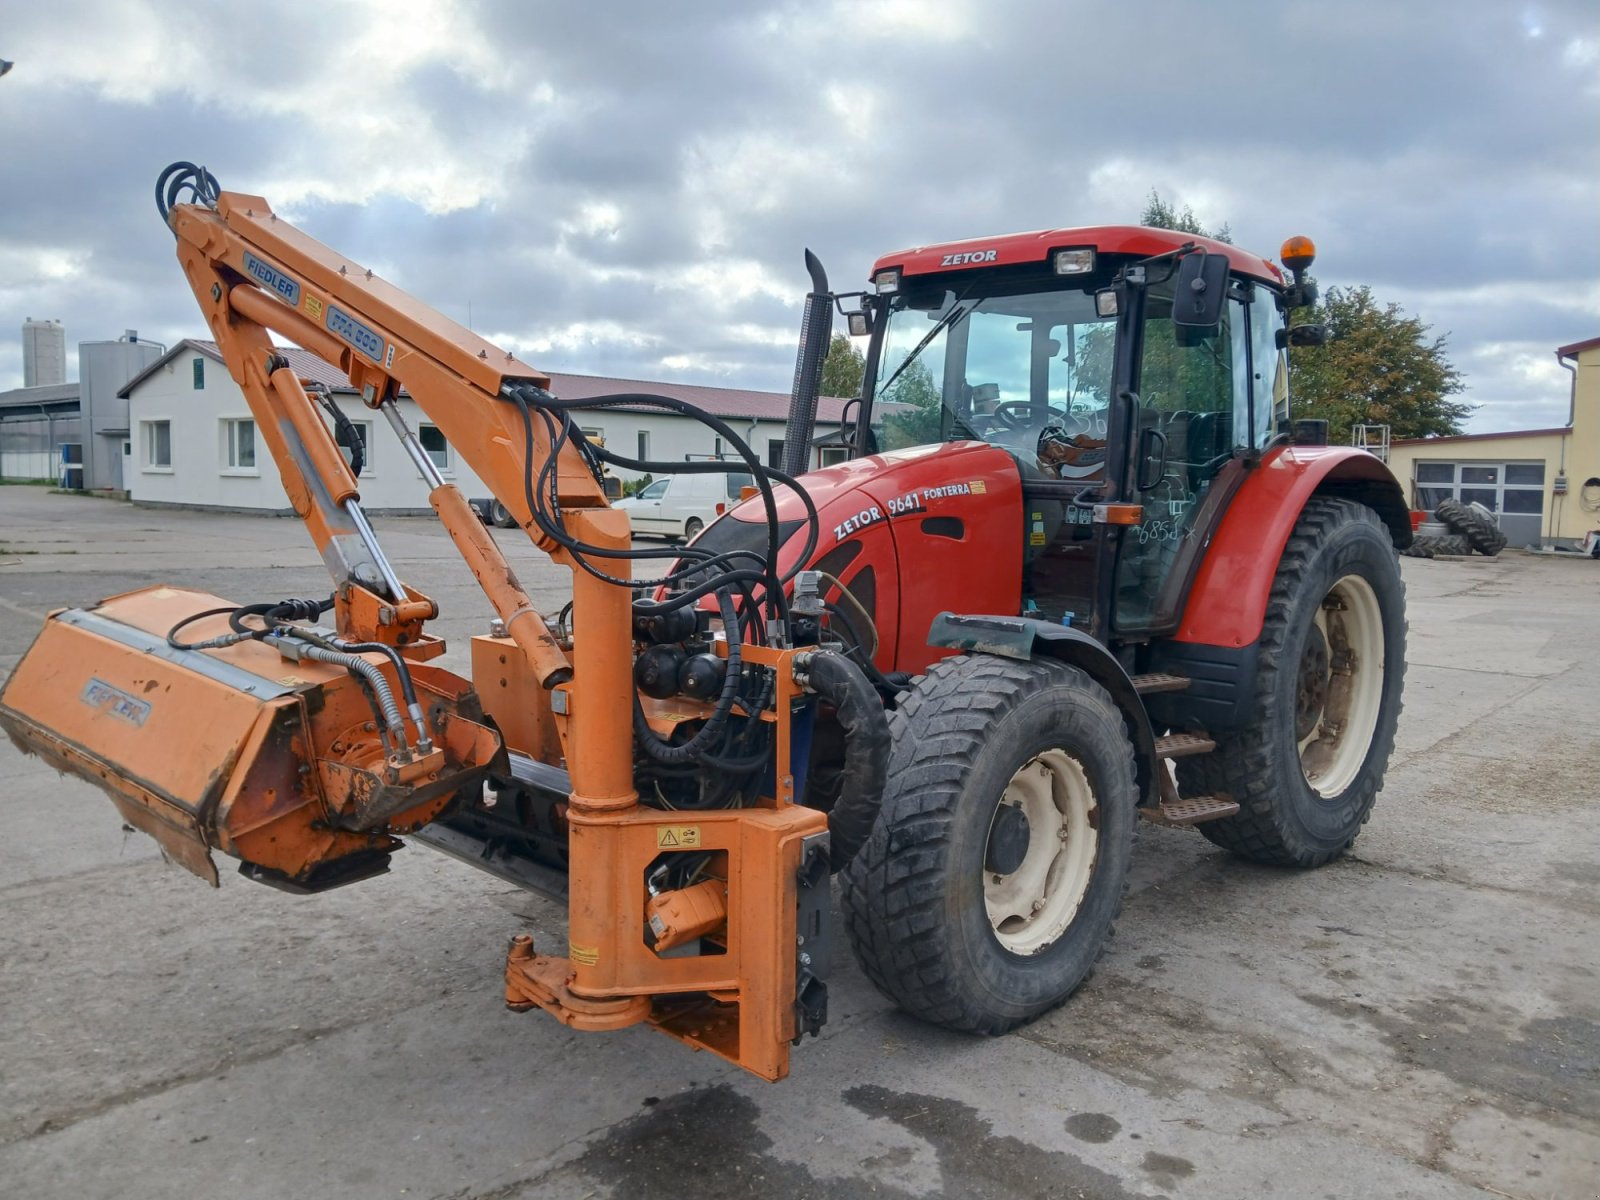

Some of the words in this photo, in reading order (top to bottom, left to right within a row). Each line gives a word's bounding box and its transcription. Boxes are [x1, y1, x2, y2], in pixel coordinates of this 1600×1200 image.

[247, 258, 294, 298] FIEDLER
[941, 249, 997, 267] ZETOR
[833, 506, 881, 542] ZETOR
[887, 493, 921, 515] 9641
[923, 483, 971, 501] FORTERRA
